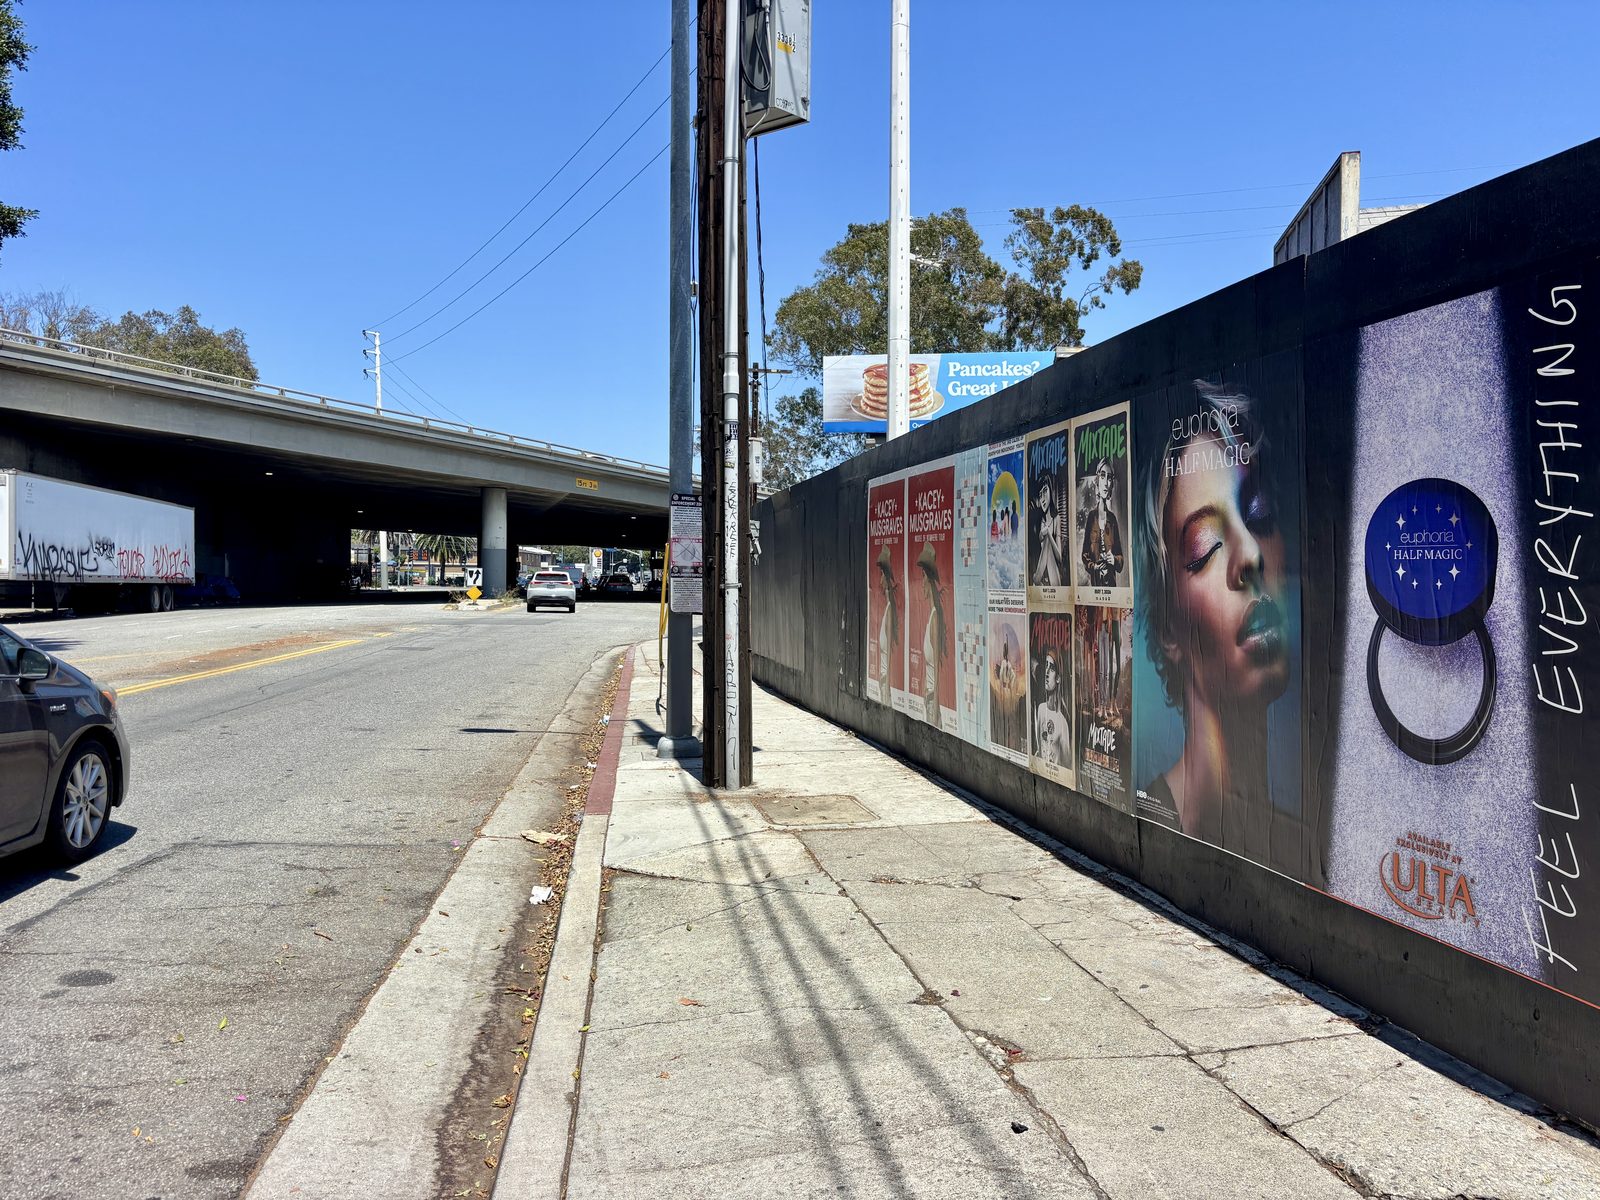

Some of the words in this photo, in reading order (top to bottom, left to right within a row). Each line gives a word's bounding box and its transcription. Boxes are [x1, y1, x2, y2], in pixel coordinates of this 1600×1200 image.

[947, 360, 1040, 377] Pancakes?
[947, 380, 998, 397] Great
[1172, 402, 1240, 443] euphoria
[1028, 435, 1067, 480] MIXTAPE
[1077, 423, 1126, 472] MIXTAPE
[877, 499, 896, 518] KACEY
[918, 488, 942, 512] KACEY
[1528, 284, 1594, 714] EVERYTHING
[870, 516, 903, 537] MUSGRAVES
[910, 509, 952, 533] MUSGRAVES
[1400, 529, 1455, 546] euphoria
[1031, 613, 1071, 654] MIXTAPE
[1088, 721, 1116, 754] MIXTAPE
[1407, 831, 1451, 851] AVAILABLE
[1392, 852, 1475, 917] ULTA
[1521, 783, 1580, 972] FEEL
[1415, 896, 1480, 928] BEAUTY
